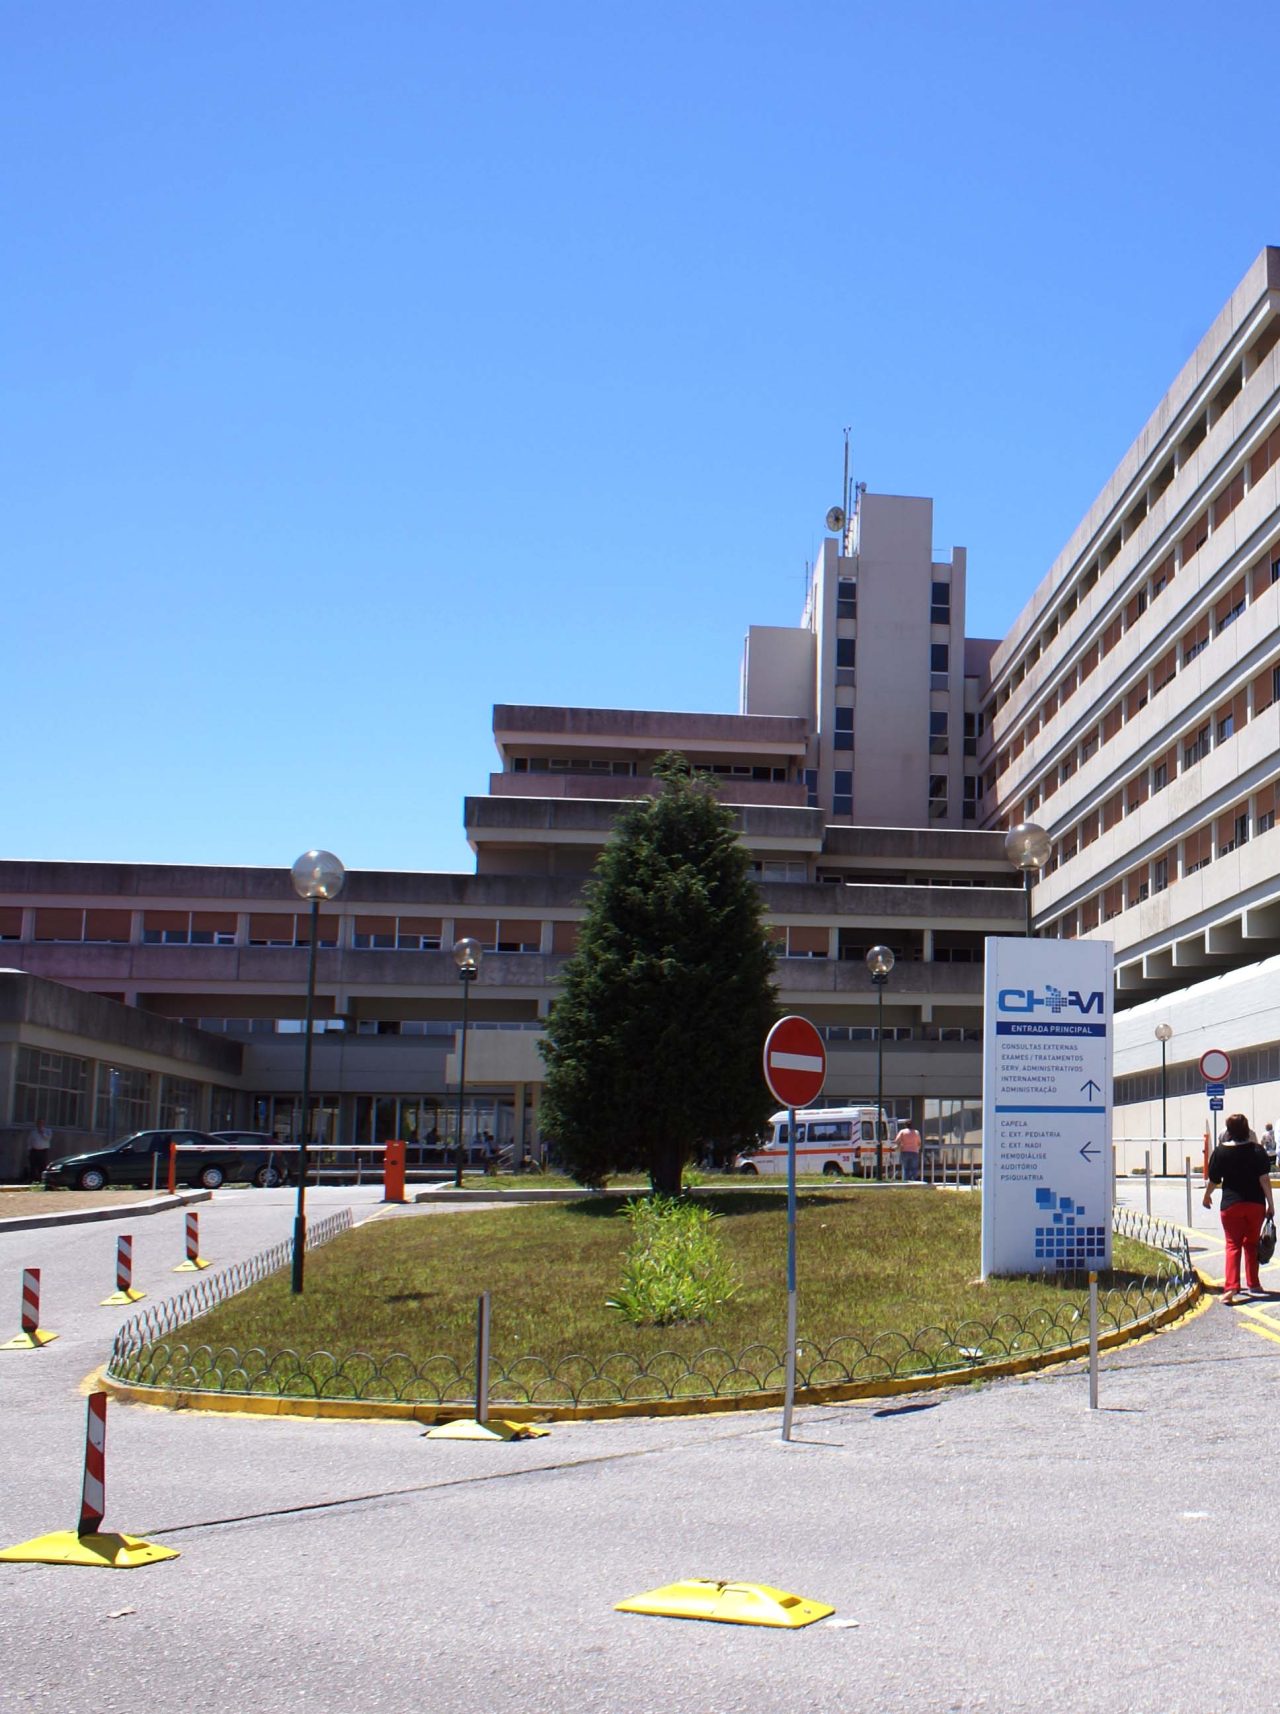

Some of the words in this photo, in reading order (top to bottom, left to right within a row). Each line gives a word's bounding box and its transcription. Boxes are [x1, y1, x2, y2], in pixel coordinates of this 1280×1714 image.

[1011, 1024, 1048, 1033] ENTRADA
[1050, 1025, 1093, 1034] PRINCIPAL
[1001, 1053, 1029, 1061] EXAMES
[1034, 1054, 1084, 1062] TRATAMENTOS
[1022, 1065, 1084, 1073] ADMINISTRATIVOS
[1001, 1075, 1056, 1083] INTERNAMENTO
[1001, 1085, 1057, 1094] ADMINISTRAÇÃO
[1000, 1152, 1047, 1160] HEMODIÁLISE
